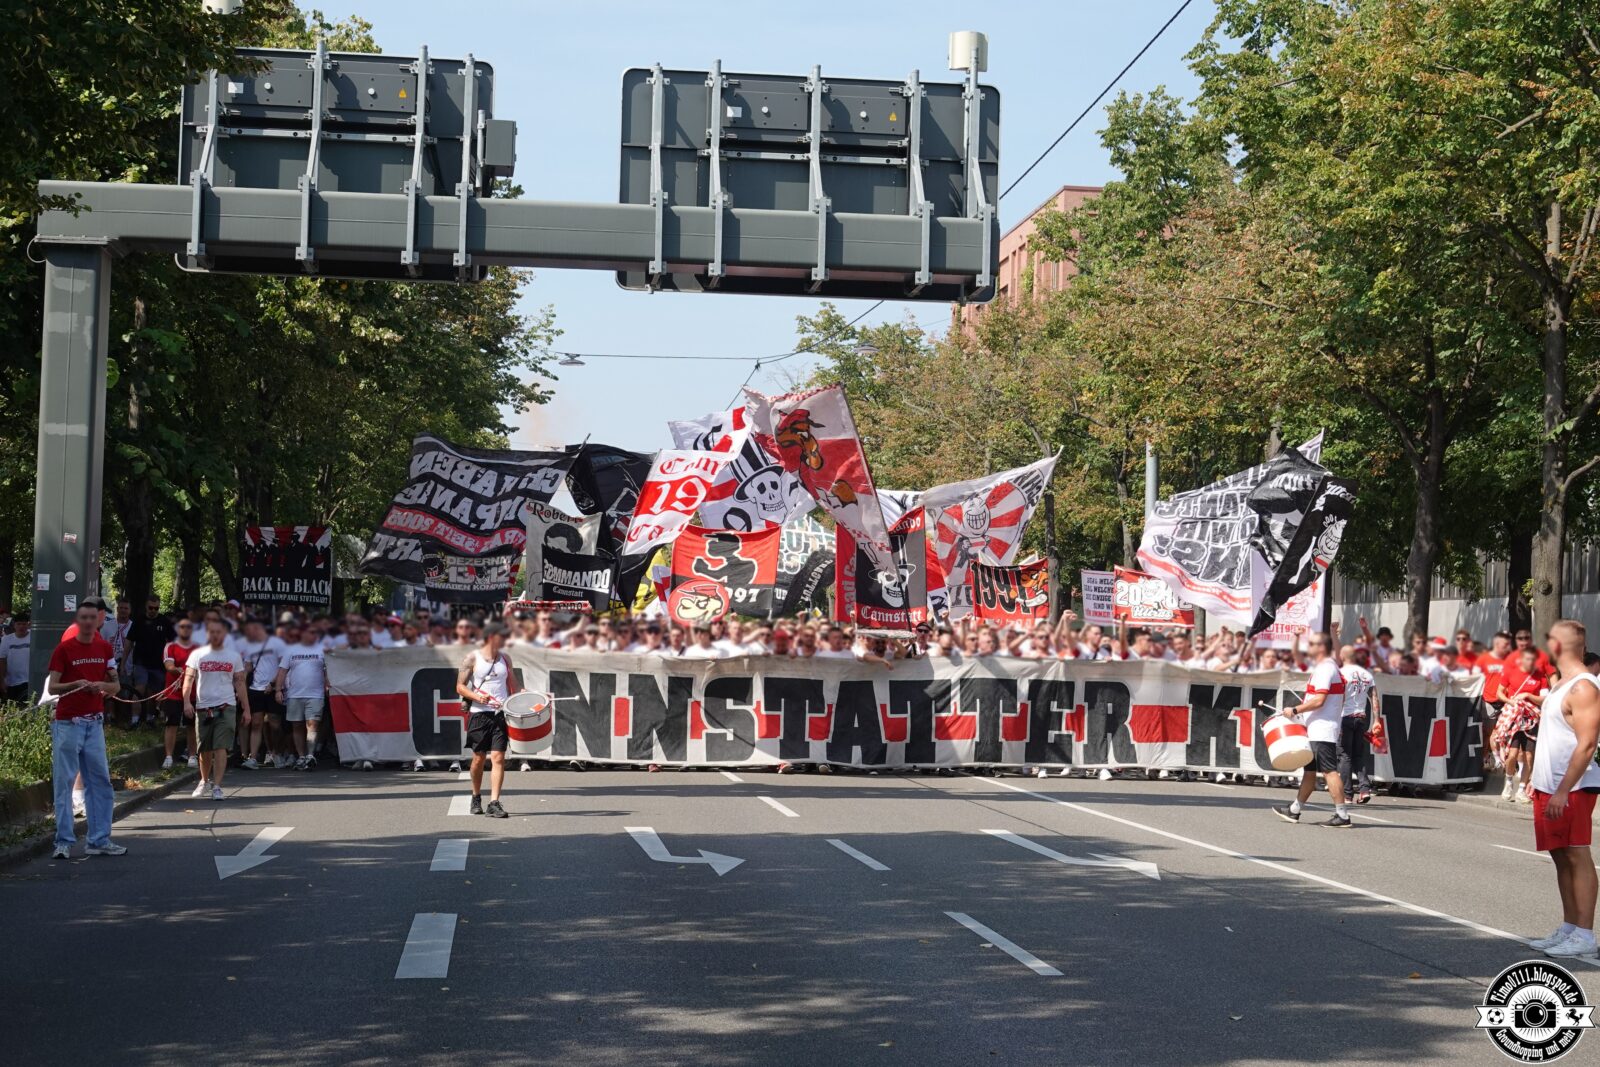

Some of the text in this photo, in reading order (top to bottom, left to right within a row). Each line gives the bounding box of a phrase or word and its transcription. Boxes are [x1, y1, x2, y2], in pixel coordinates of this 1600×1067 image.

[543, 558, 611, 589] COMMANDO
[242, 577, 331, 596] BACK in BLACK
[553, 585, 584, 598] Cannstatt
[411, 667, 1141, 765] CNNSTATTER
